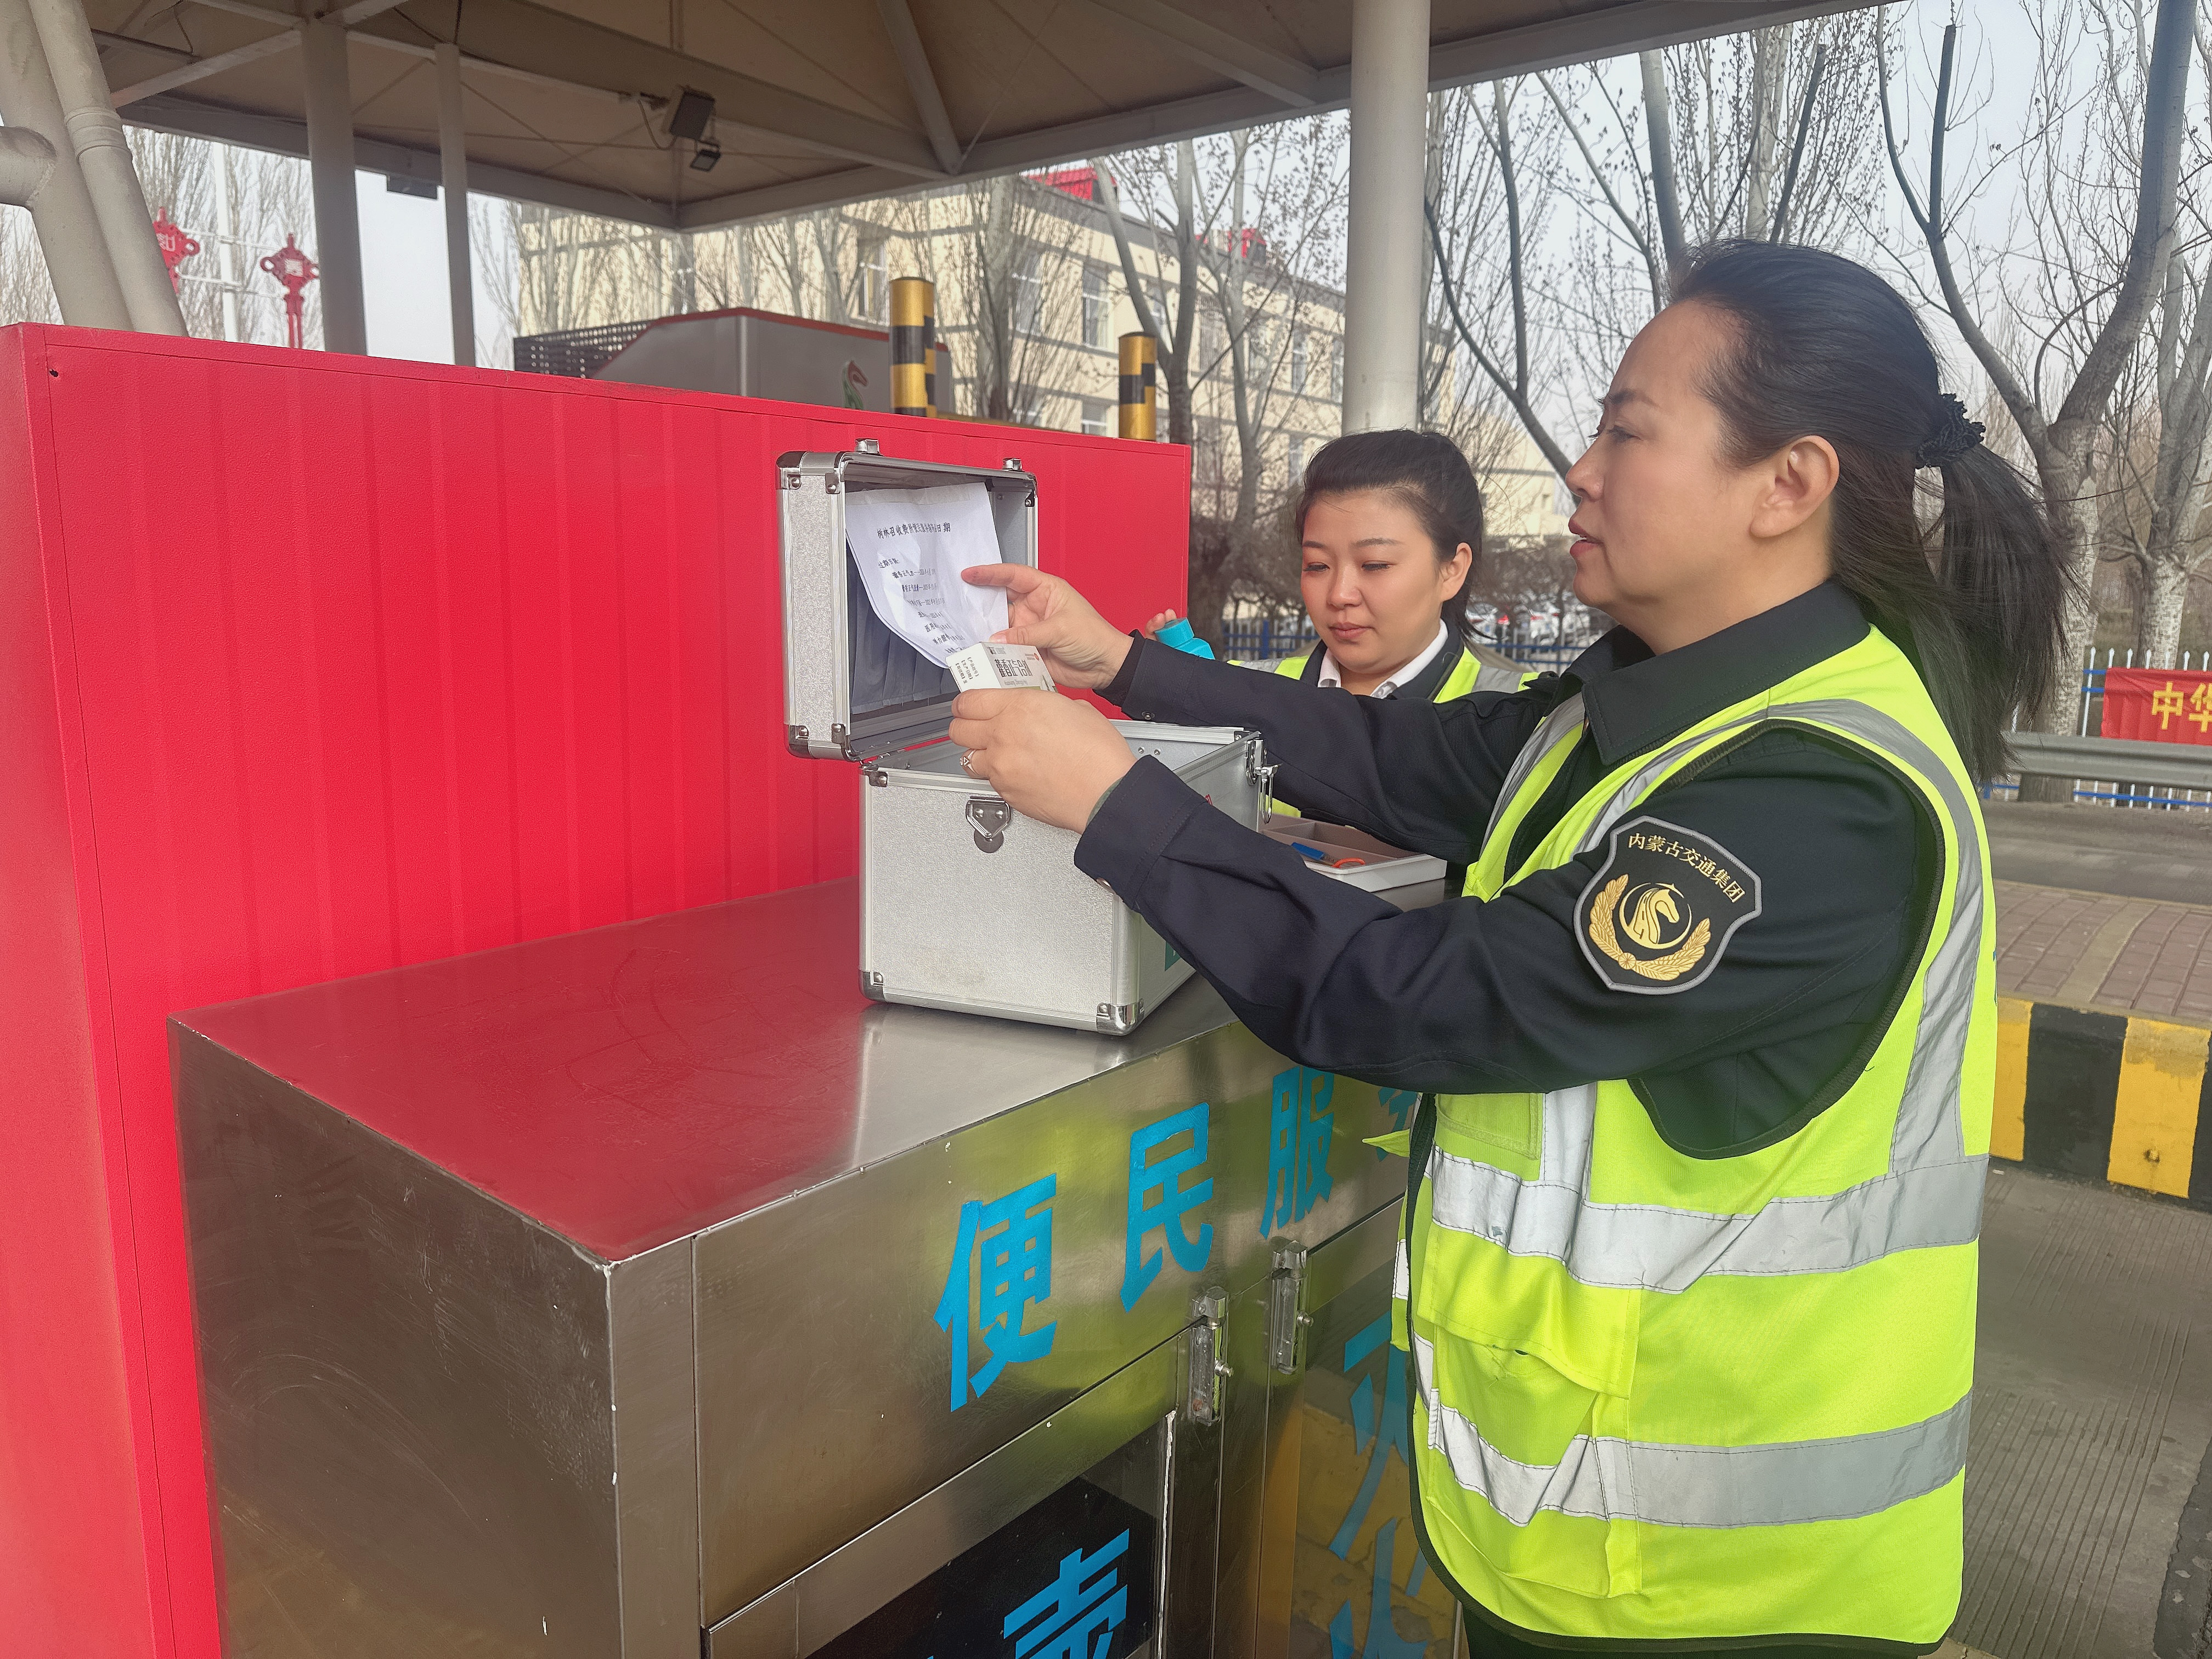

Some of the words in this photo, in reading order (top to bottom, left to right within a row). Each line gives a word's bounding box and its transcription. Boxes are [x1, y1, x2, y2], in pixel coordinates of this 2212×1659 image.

[1628, 833, 1745, 903] 内蒙古交通集团
